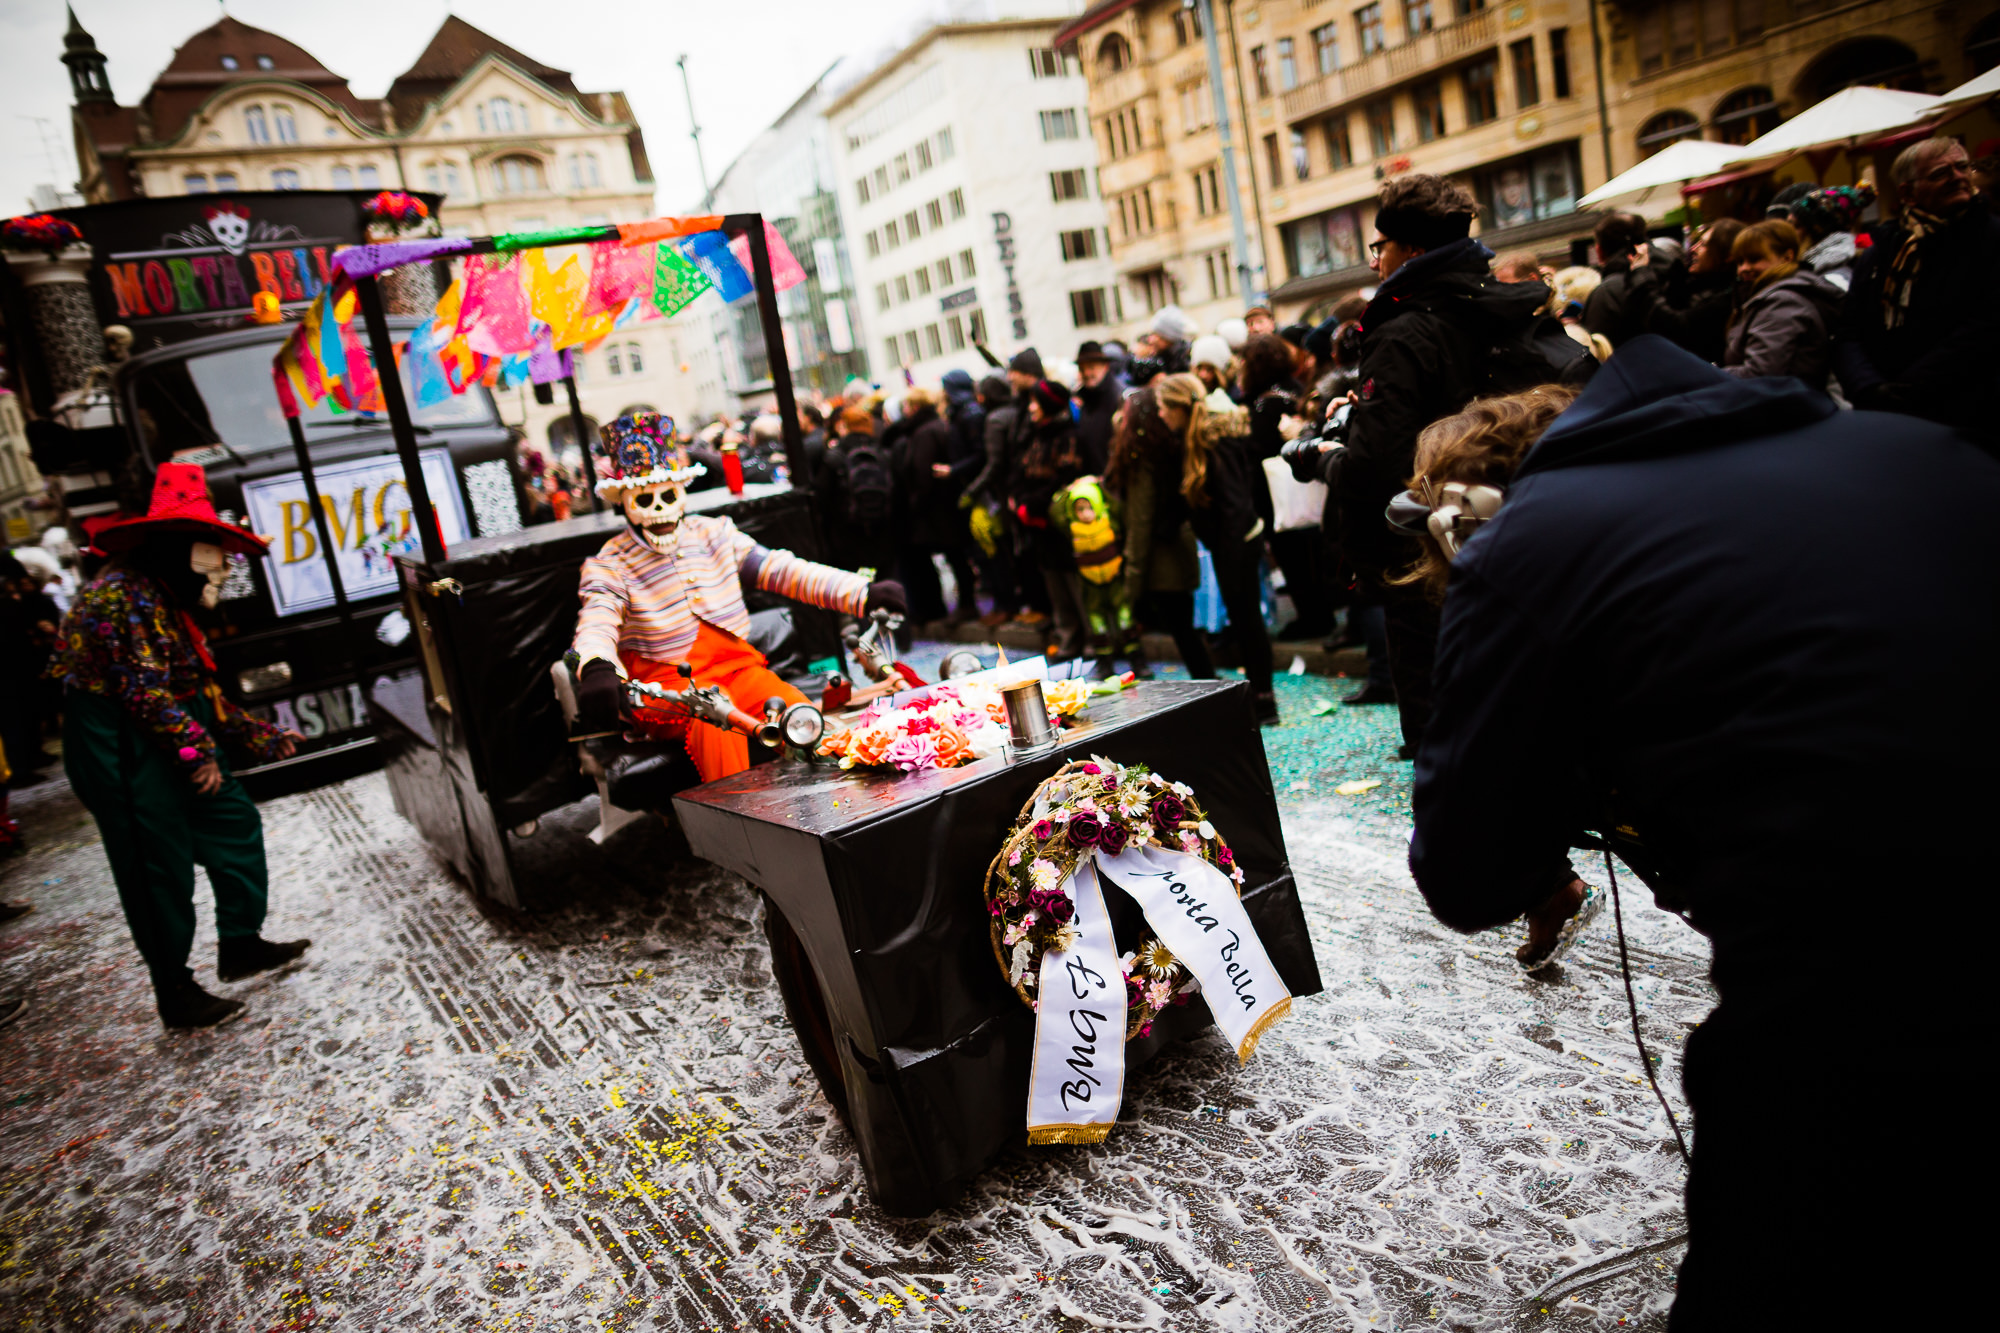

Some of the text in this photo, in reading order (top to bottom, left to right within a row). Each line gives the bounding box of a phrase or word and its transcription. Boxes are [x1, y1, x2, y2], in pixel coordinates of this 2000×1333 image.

[104, 253, 249, 317] MORTA
[280, 479, 411, 564] BMG
[1220, 928, 1256, 1012] Bella
[1060, 1009, 1108, 1112] BMG
